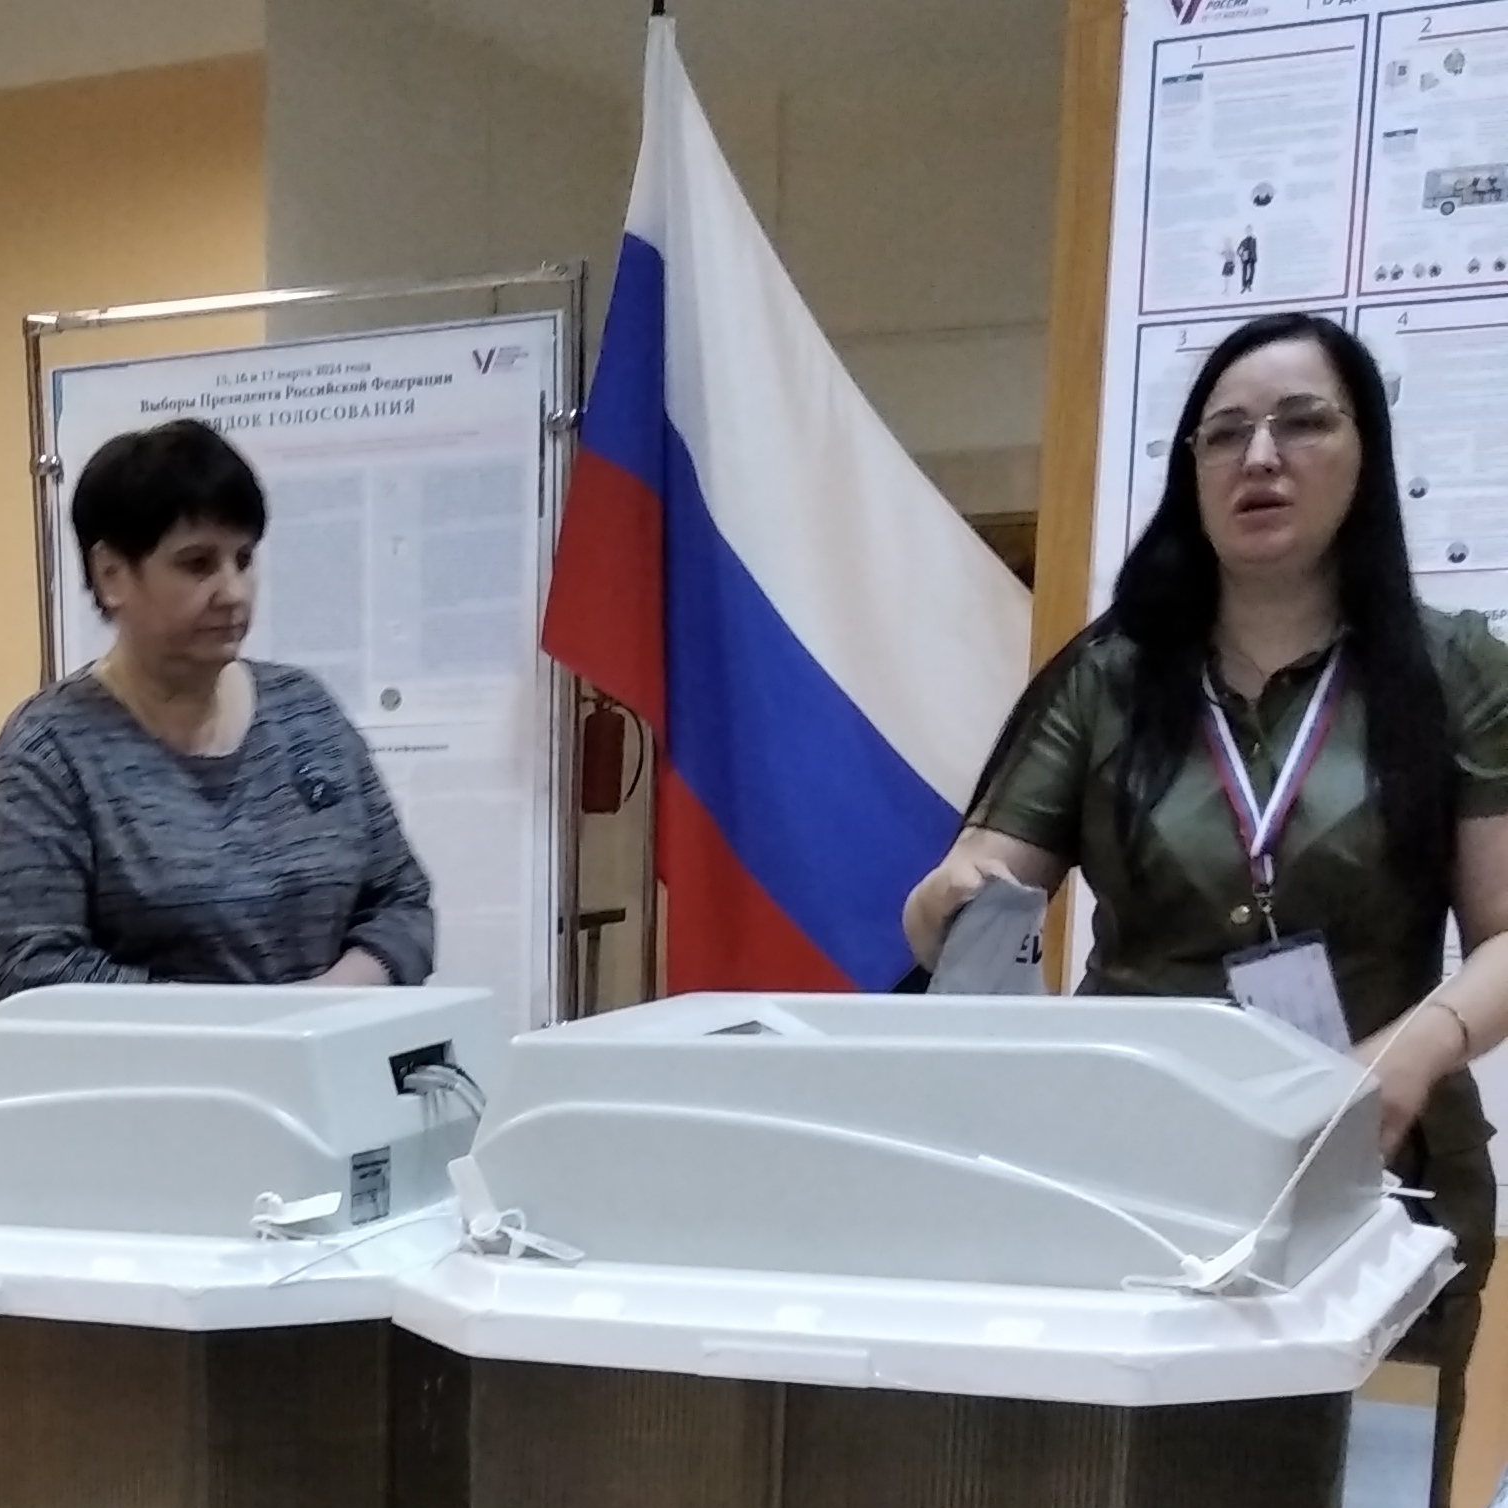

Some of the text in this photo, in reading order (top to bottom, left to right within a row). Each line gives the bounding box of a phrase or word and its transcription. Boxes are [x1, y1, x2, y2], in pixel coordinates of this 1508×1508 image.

[1421, 16, 1432, 33] 2
[1398, 311, 1408, 325] 4
[1178, 328, 1187, 345] 3
[140, 372, 453, 413] Выборы Президента Российской Федерации
[269, 397, 416, 426] ГОЛОСОВАНИЯ
